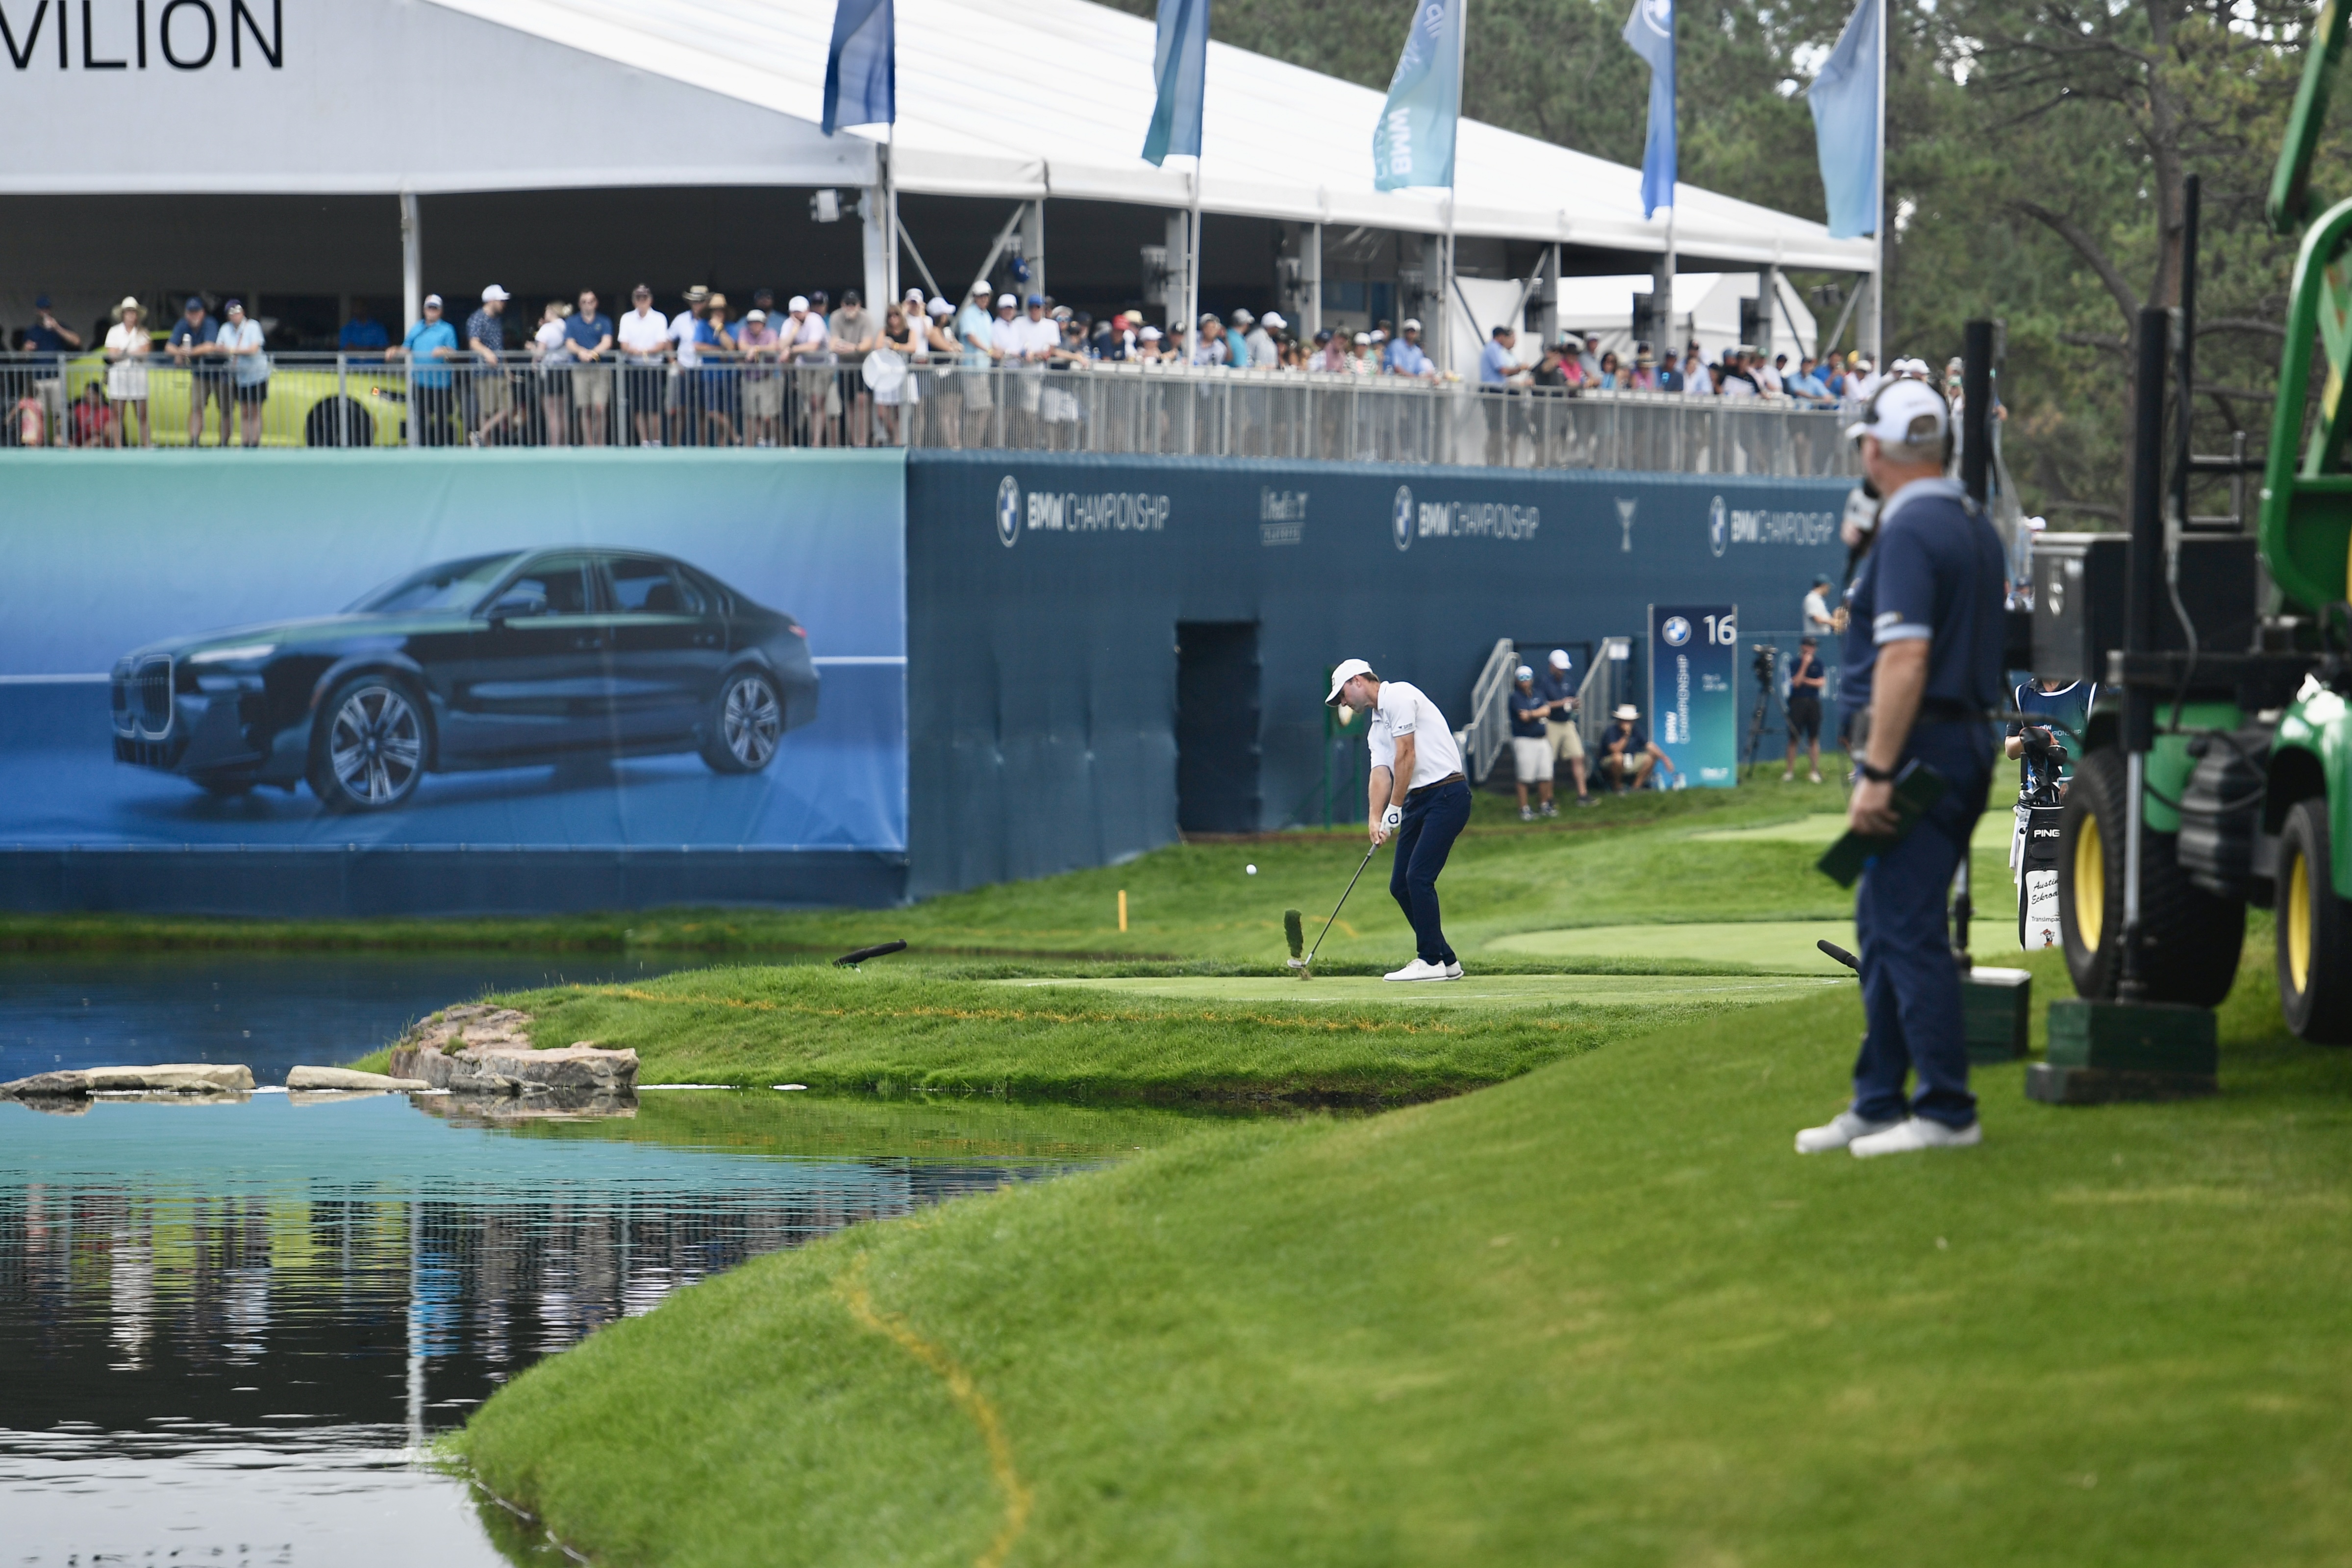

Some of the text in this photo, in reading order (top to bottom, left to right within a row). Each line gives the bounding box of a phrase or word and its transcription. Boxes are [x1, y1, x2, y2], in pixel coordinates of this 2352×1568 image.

[1027, 492, 1170, 532] BMW CHAMPIONSHIP
[1418, 501, 1540, 540] BMW CHAMPIONSHIP
[1730, 509, 1758, 543] BMW
[1703, 614, 1737, 645] 16
[2034, 829, 2060, 838] PING
[2031, 891, 2059, 905] Eckroa
